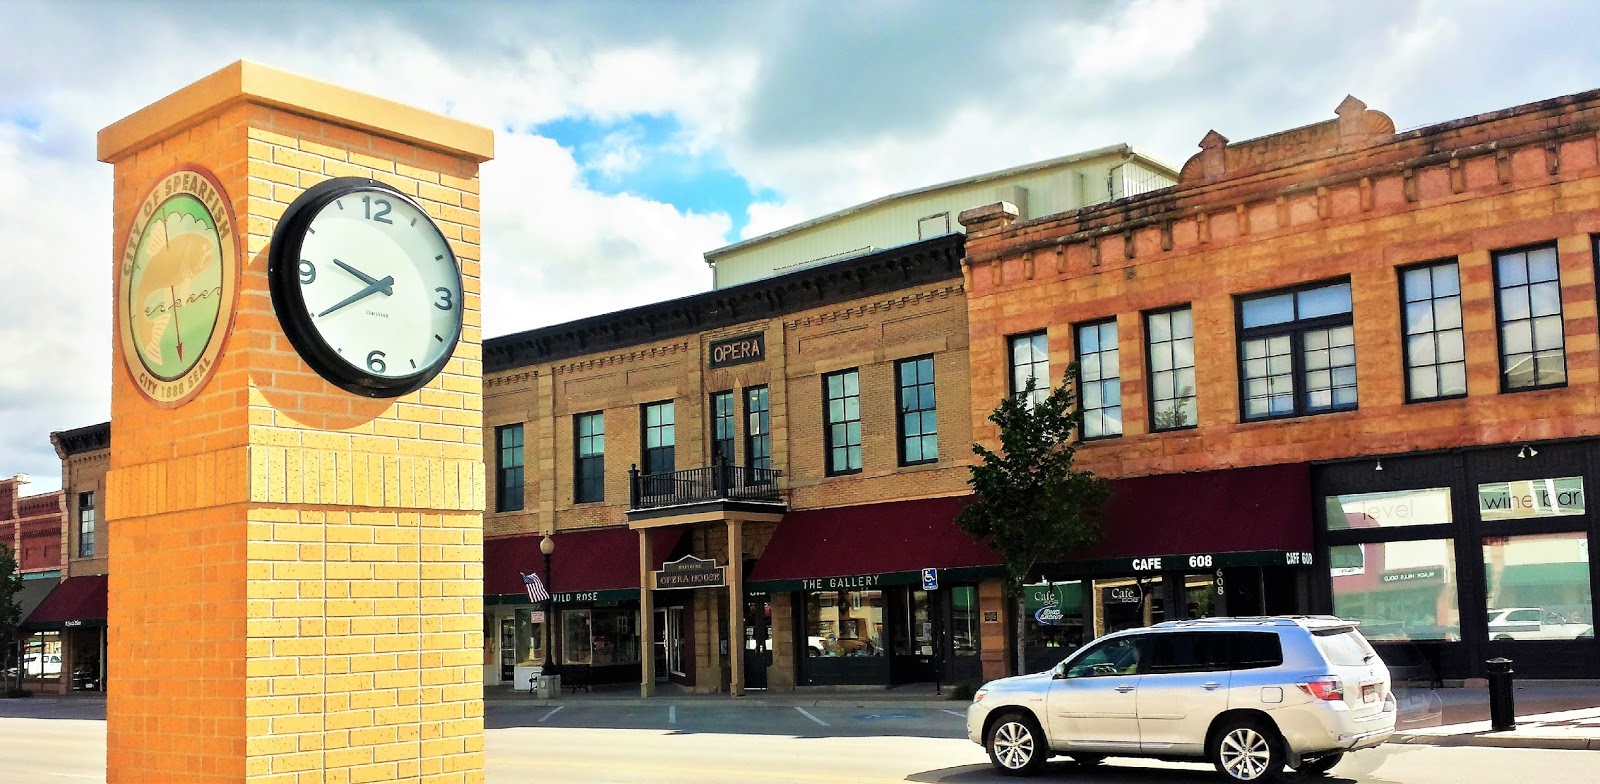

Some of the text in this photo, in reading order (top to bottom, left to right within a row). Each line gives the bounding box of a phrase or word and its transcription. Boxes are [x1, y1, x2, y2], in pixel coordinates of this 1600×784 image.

[362, 195, 393, 225] 12
[123, 174, 230, 276] CITY OF SPEARFISH
[299, 259, 316, 285] 9
[434, 286, 453, 311] 3
[366, 350, 387, 374] 6
[714, 339, 760, 363] OPERA
[139, 357, 211, 398] CITY 1888 SEAL
[1362, 499, 1414, 521] level
[1484, 489, 1580, 510] wine bar
[1132, 555, 1213, 571] CAFE 608
[1286, 552, 1300, 565] CAFE
[660, 573, 720, 584] OPERA HOUSE
[802, 574, 879, 590] THE GALLERY
[1216, 568, 1224, 595] 608
[552, 592, 598, 602] WILD ROSE
